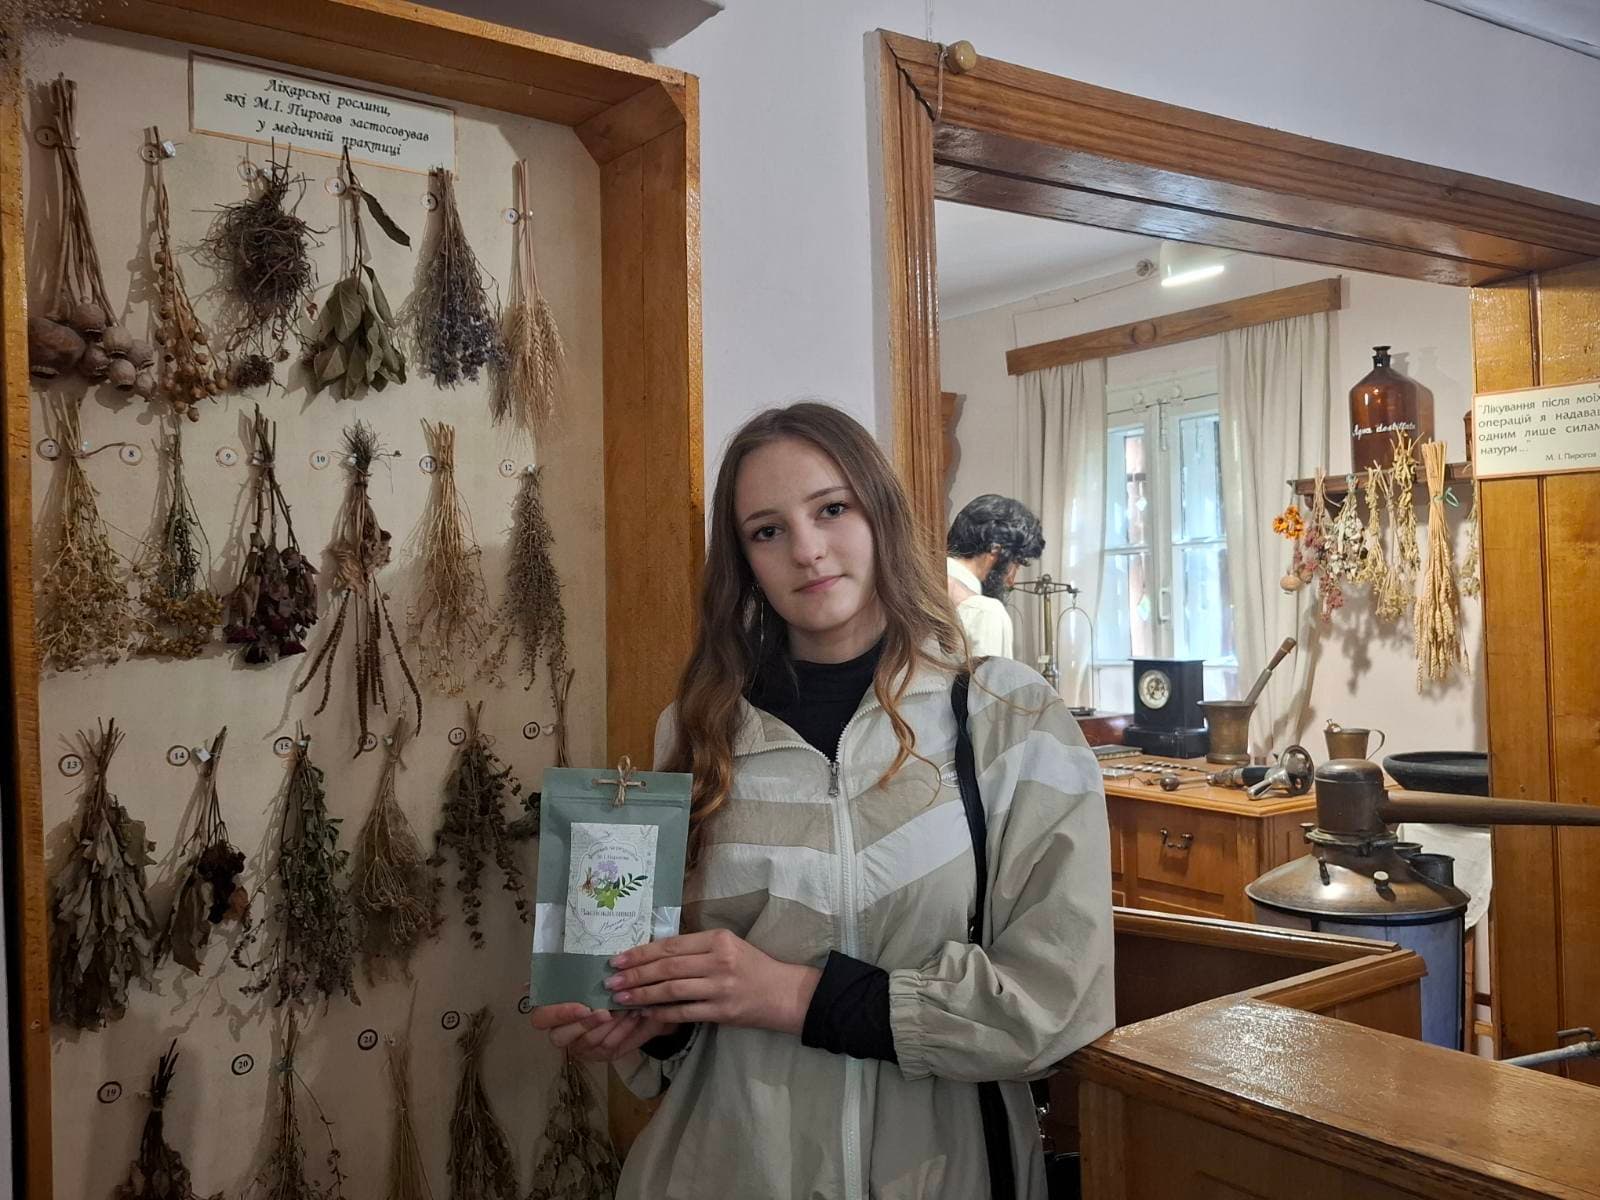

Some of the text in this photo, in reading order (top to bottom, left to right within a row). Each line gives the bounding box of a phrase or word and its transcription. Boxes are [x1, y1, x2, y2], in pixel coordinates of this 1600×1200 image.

[264, 79, 391, 117] Лікарські рослини,
[223, 93, 247, 108] які
[286, 102, 343, 124] Пирогов
[349, 118, 430, 142] застосовував
[255, 119, 402, 156] у медичній практиці
[1542, 397, 1570, 408] після
[1478, 414, 1531, 428] операцій
[1540, 414, 1546, 422] я
[1478, 431, 1516, 442] одним
[1524, 427, 1557, 438] лише
